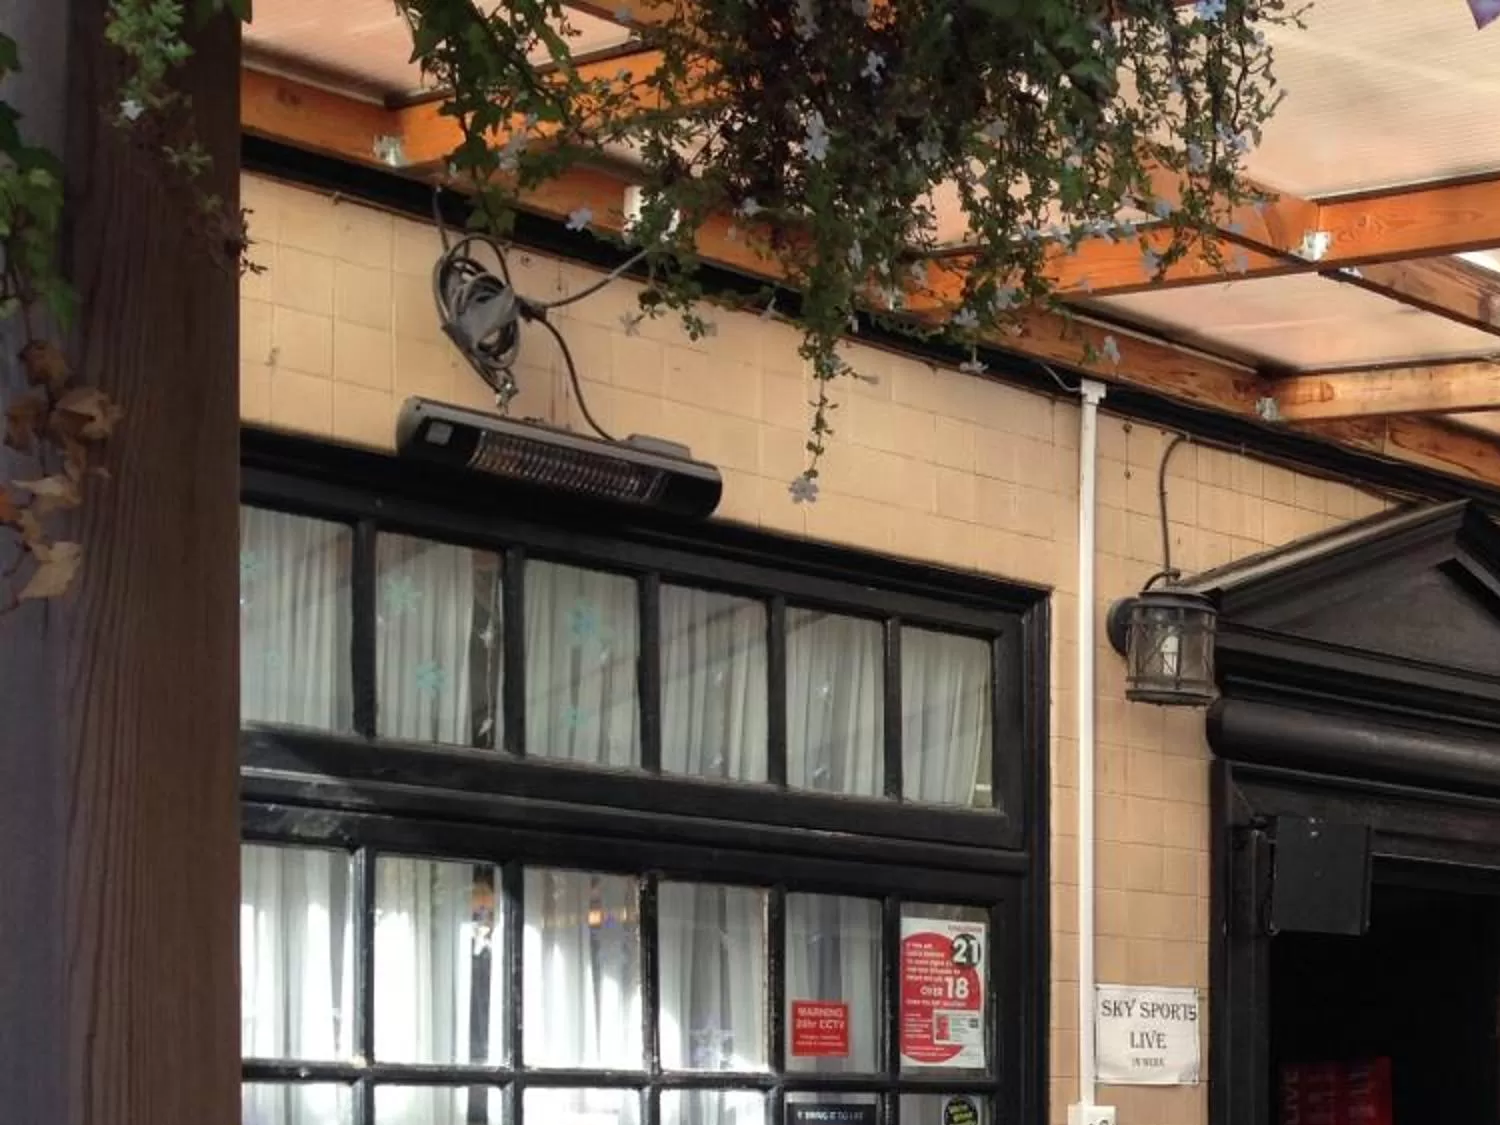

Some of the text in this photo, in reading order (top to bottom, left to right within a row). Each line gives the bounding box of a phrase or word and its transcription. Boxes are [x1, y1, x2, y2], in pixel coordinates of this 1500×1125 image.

[953, 938, 980, 965] 21
[944, 976, 970, 999] 18
[1101, 998, 1197, 1021] SKY SPORTS
[1130, 1031, 1167, 1049] LIVE
